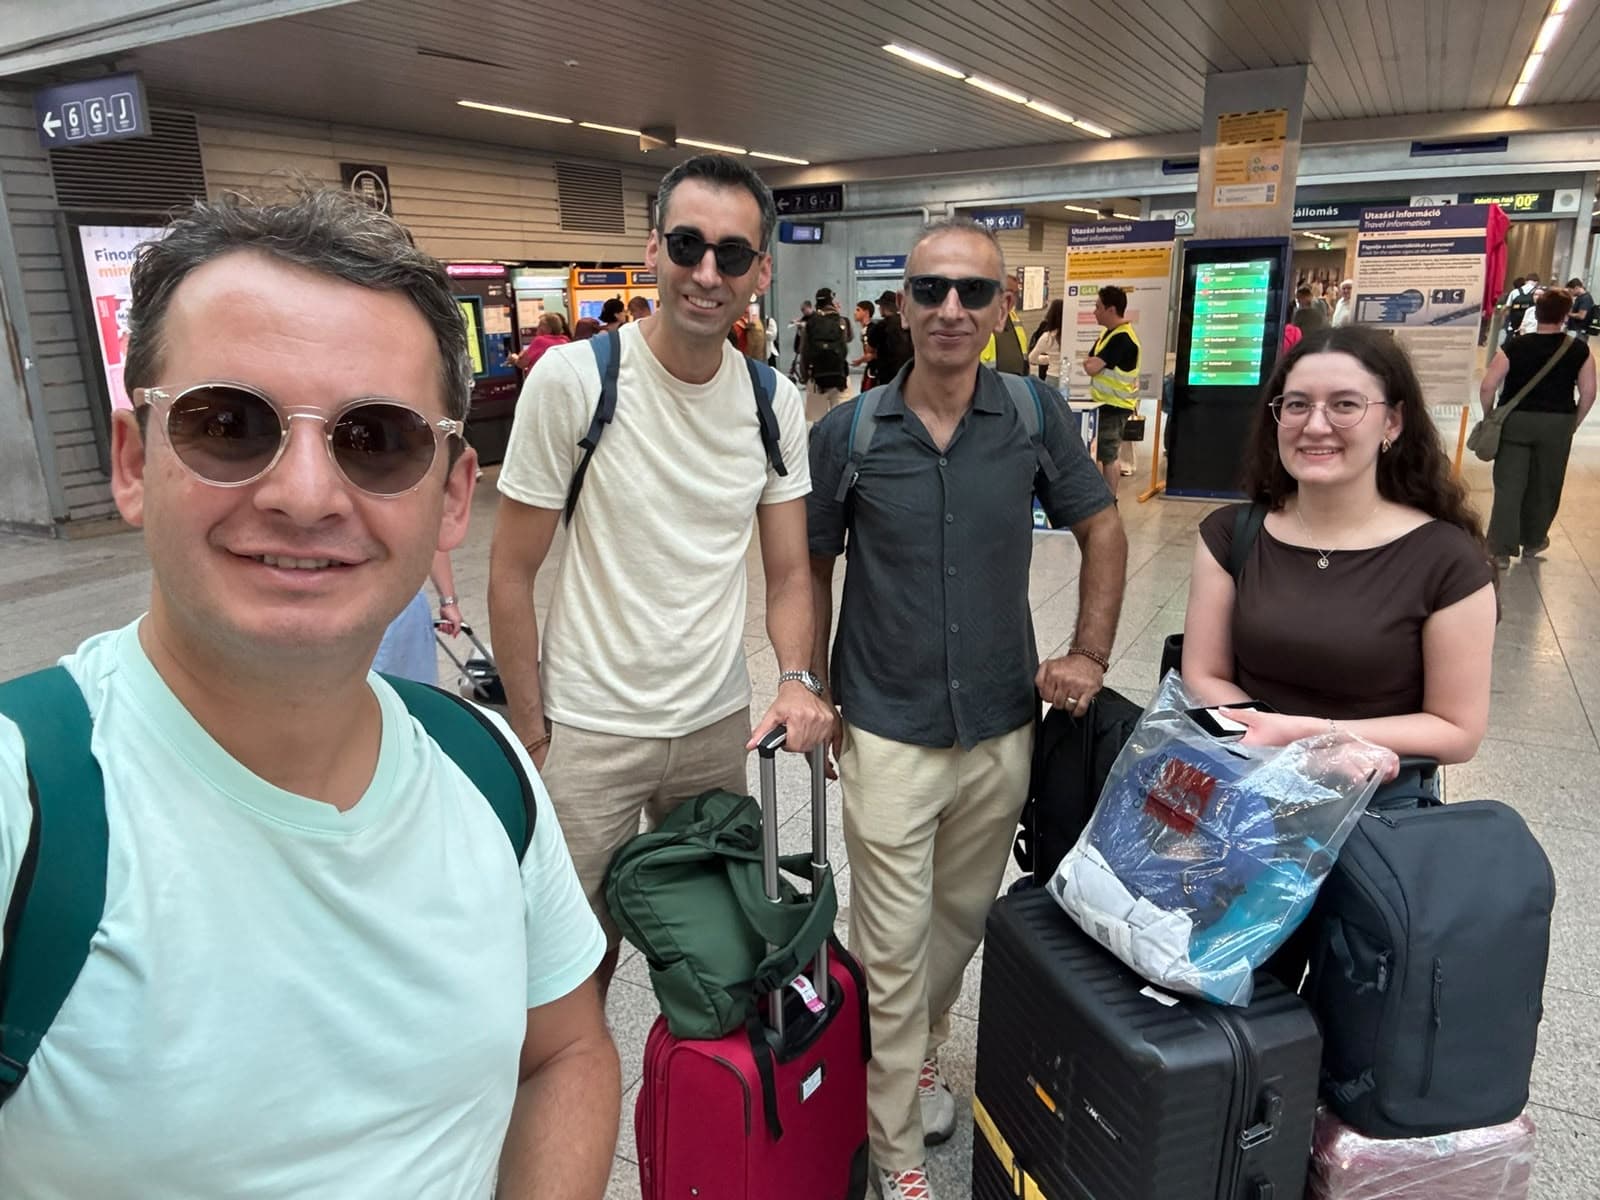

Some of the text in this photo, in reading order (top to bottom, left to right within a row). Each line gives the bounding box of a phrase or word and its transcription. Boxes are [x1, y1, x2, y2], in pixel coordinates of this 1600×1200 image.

[69, 107, 78, 127] 6
[795, 197, 802, 207] 7
[1516, 195, 1532, 207] 00
[1364, 208, 1441, 220] Utazási információ
[1364, 219, 1431, 229] Travel information
[1071, 227, 1096, 235] Utazási
[1436, 290, 1460, 300] 4 C
